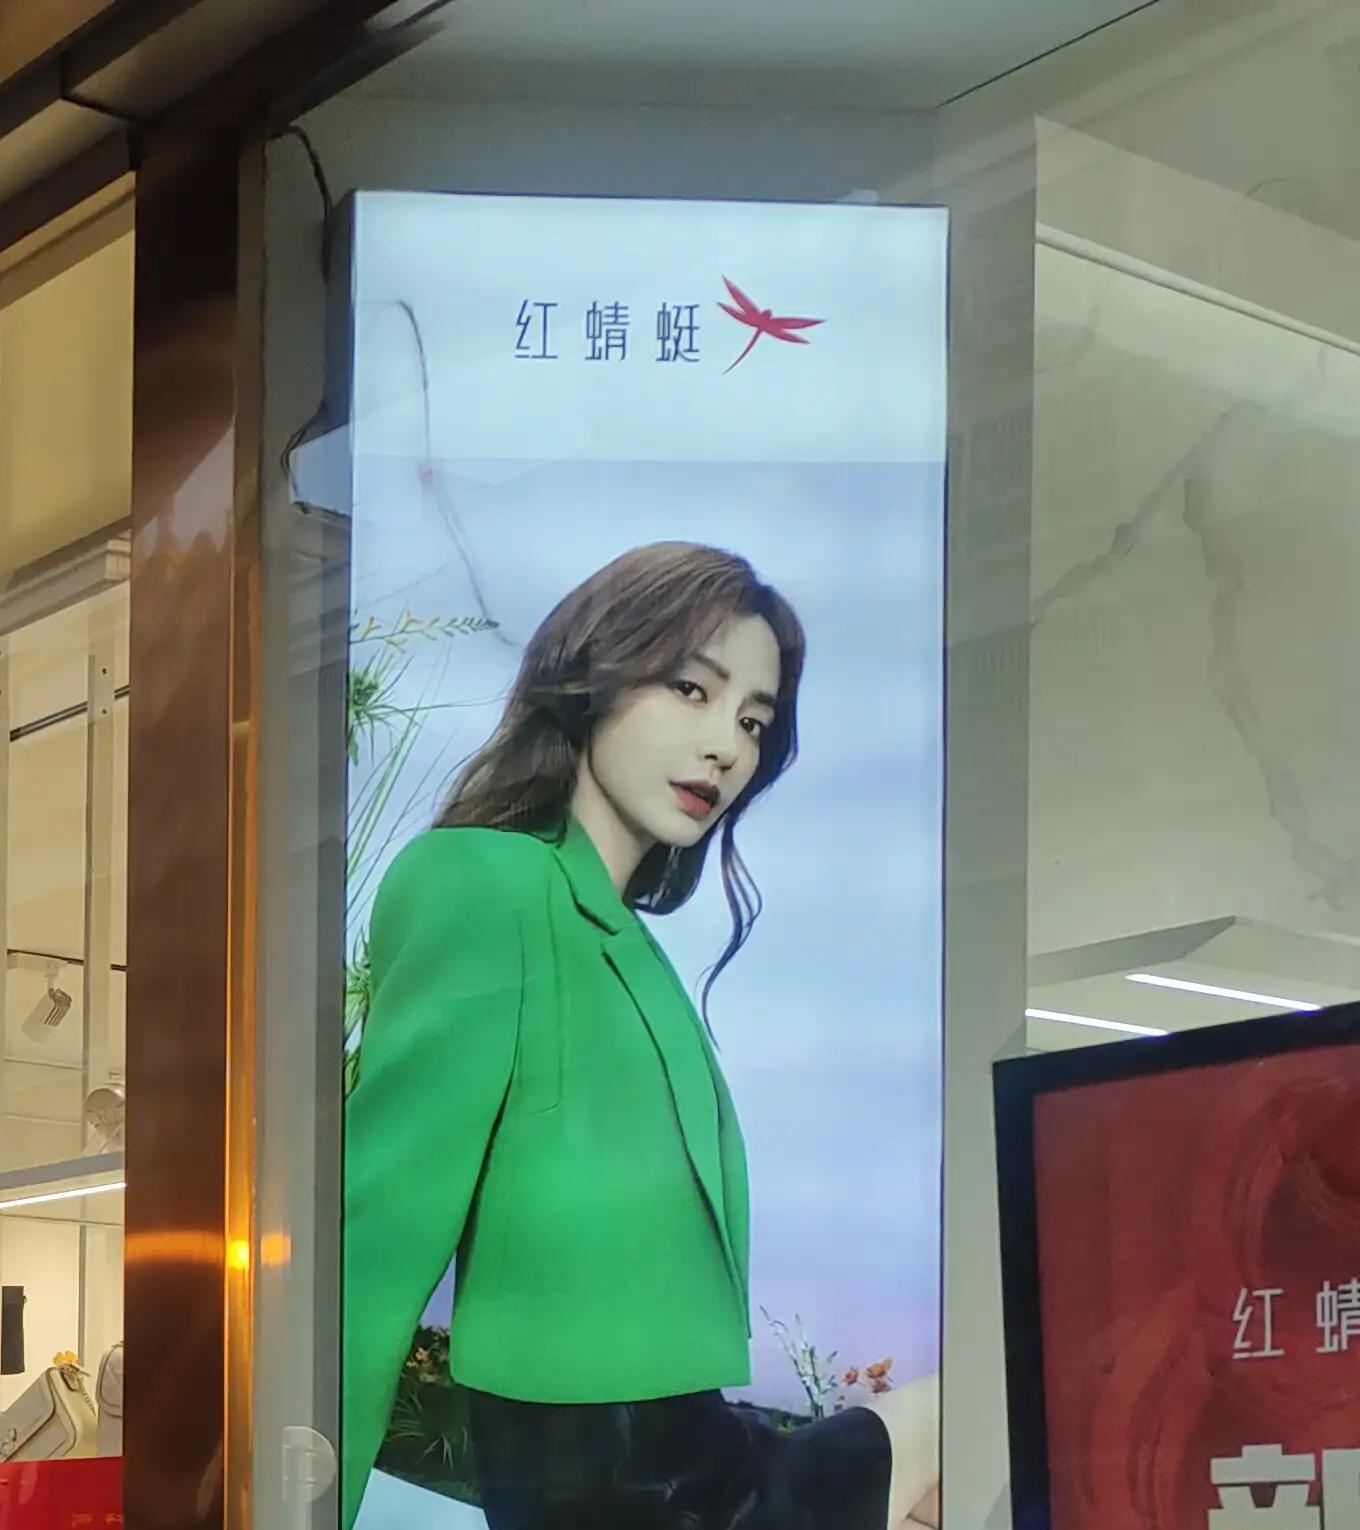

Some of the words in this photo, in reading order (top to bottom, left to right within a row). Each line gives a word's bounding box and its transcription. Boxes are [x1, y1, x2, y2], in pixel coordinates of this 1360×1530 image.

[514, 298, 701, 363] 红蜻蜓
[1232, 1278, 1360, 1359] 红蜻
